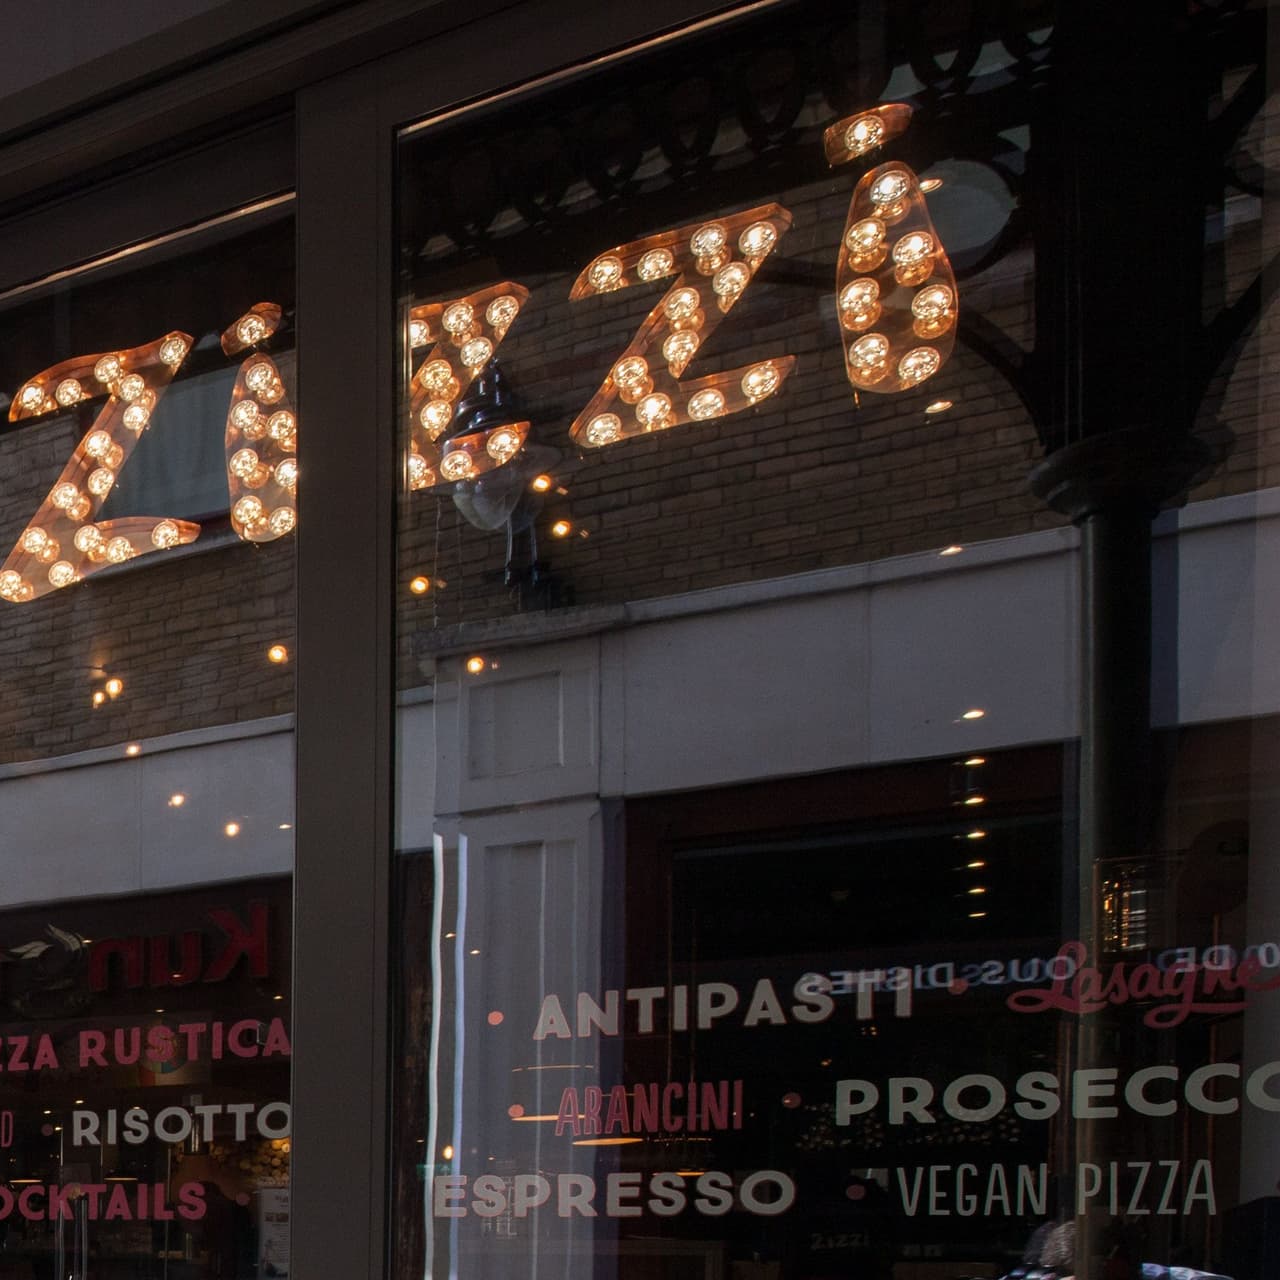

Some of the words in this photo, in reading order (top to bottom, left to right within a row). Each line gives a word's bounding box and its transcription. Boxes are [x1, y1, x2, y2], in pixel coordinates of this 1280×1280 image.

[532, 968, 912, 1040] ANTIPASTI
[1007, 941, 1280, 1029] Lasagne
[78, 1017, 292, 1067] RUSTICA
[72, 1101, 292, 1147] RISOTTO
[555, 1079, 745, 1137] ARANCINI
[433, 1169, 797, 1219] ESPRESSO
[896, 1161, 1048, 1217] VEGAN
[1078, 1159, 1218, 1217] PIZZA
